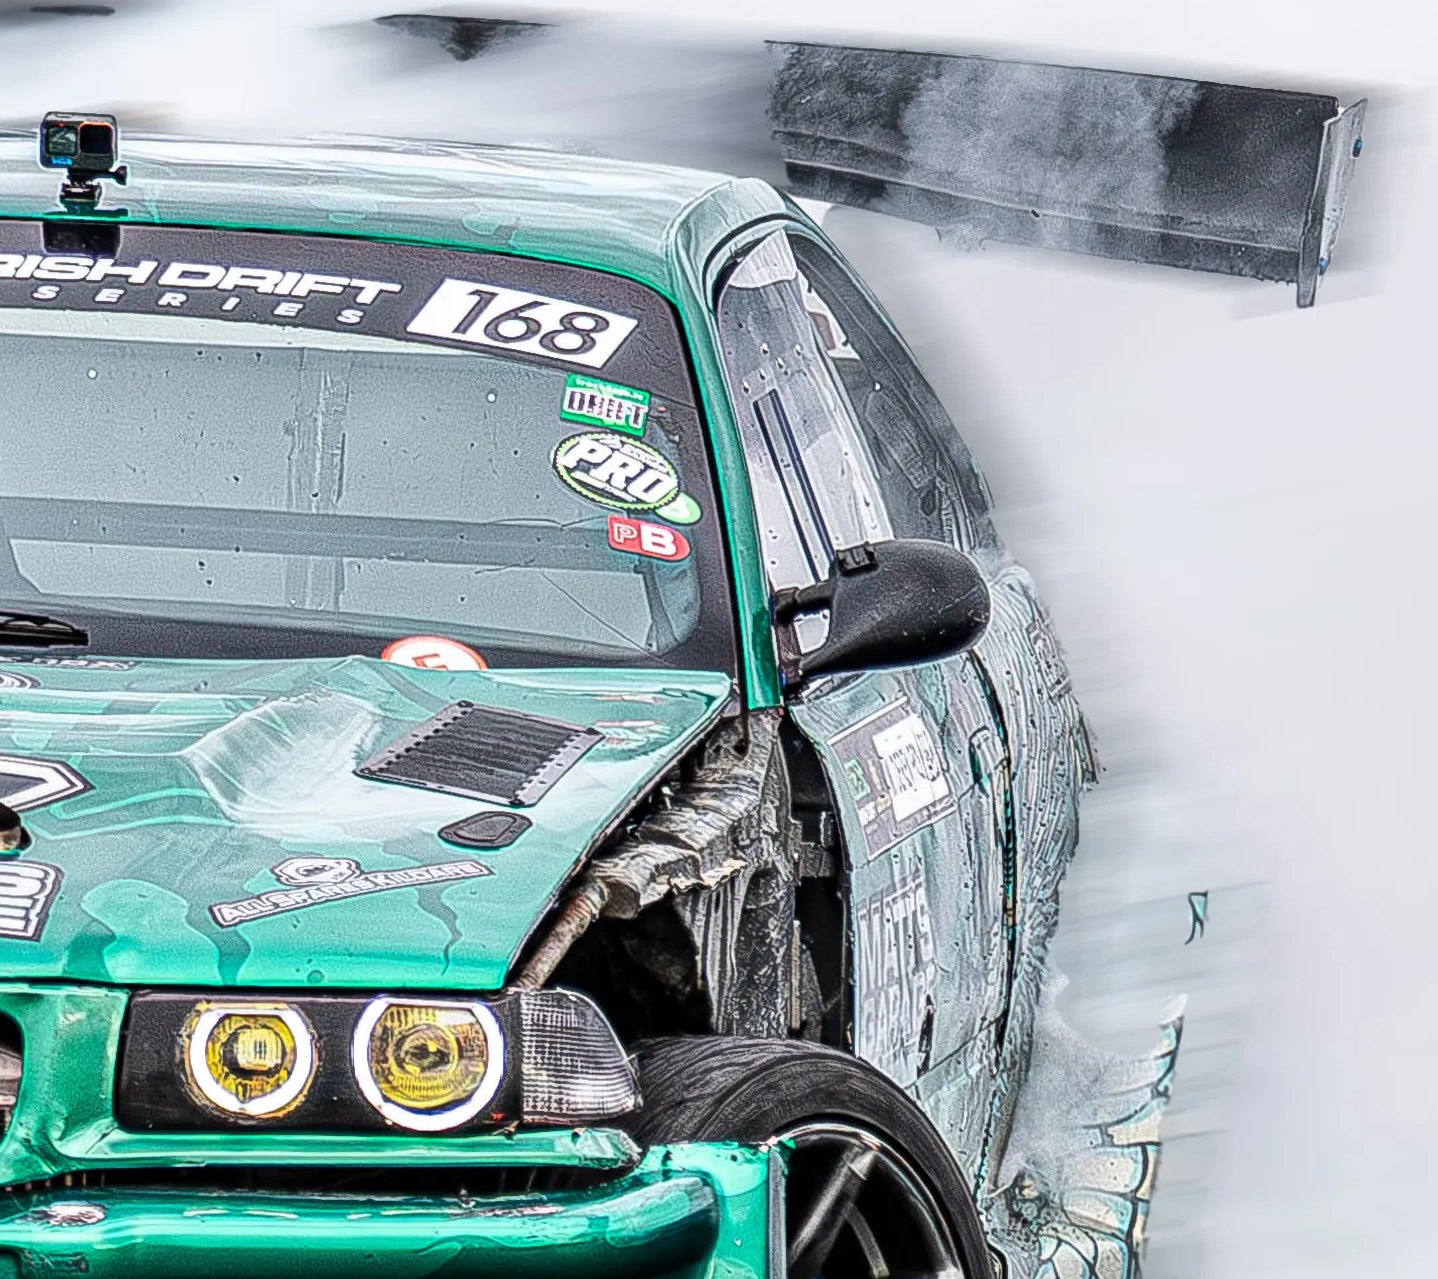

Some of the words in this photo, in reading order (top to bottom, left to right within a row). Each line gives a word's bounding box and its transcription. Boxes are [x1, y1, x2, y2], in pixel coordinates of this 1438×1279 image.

[32, 285, 365, 324] SERIES
[158, 262, 402, 305] DRIFT
[451, 288, 610, 355] 168
[562, 438, 678, 504] PRO
[221, 897, 275, 921] ALL
[272, 879, 373, 907] SPARES
[372, 863, 482, 889] KILDARE
